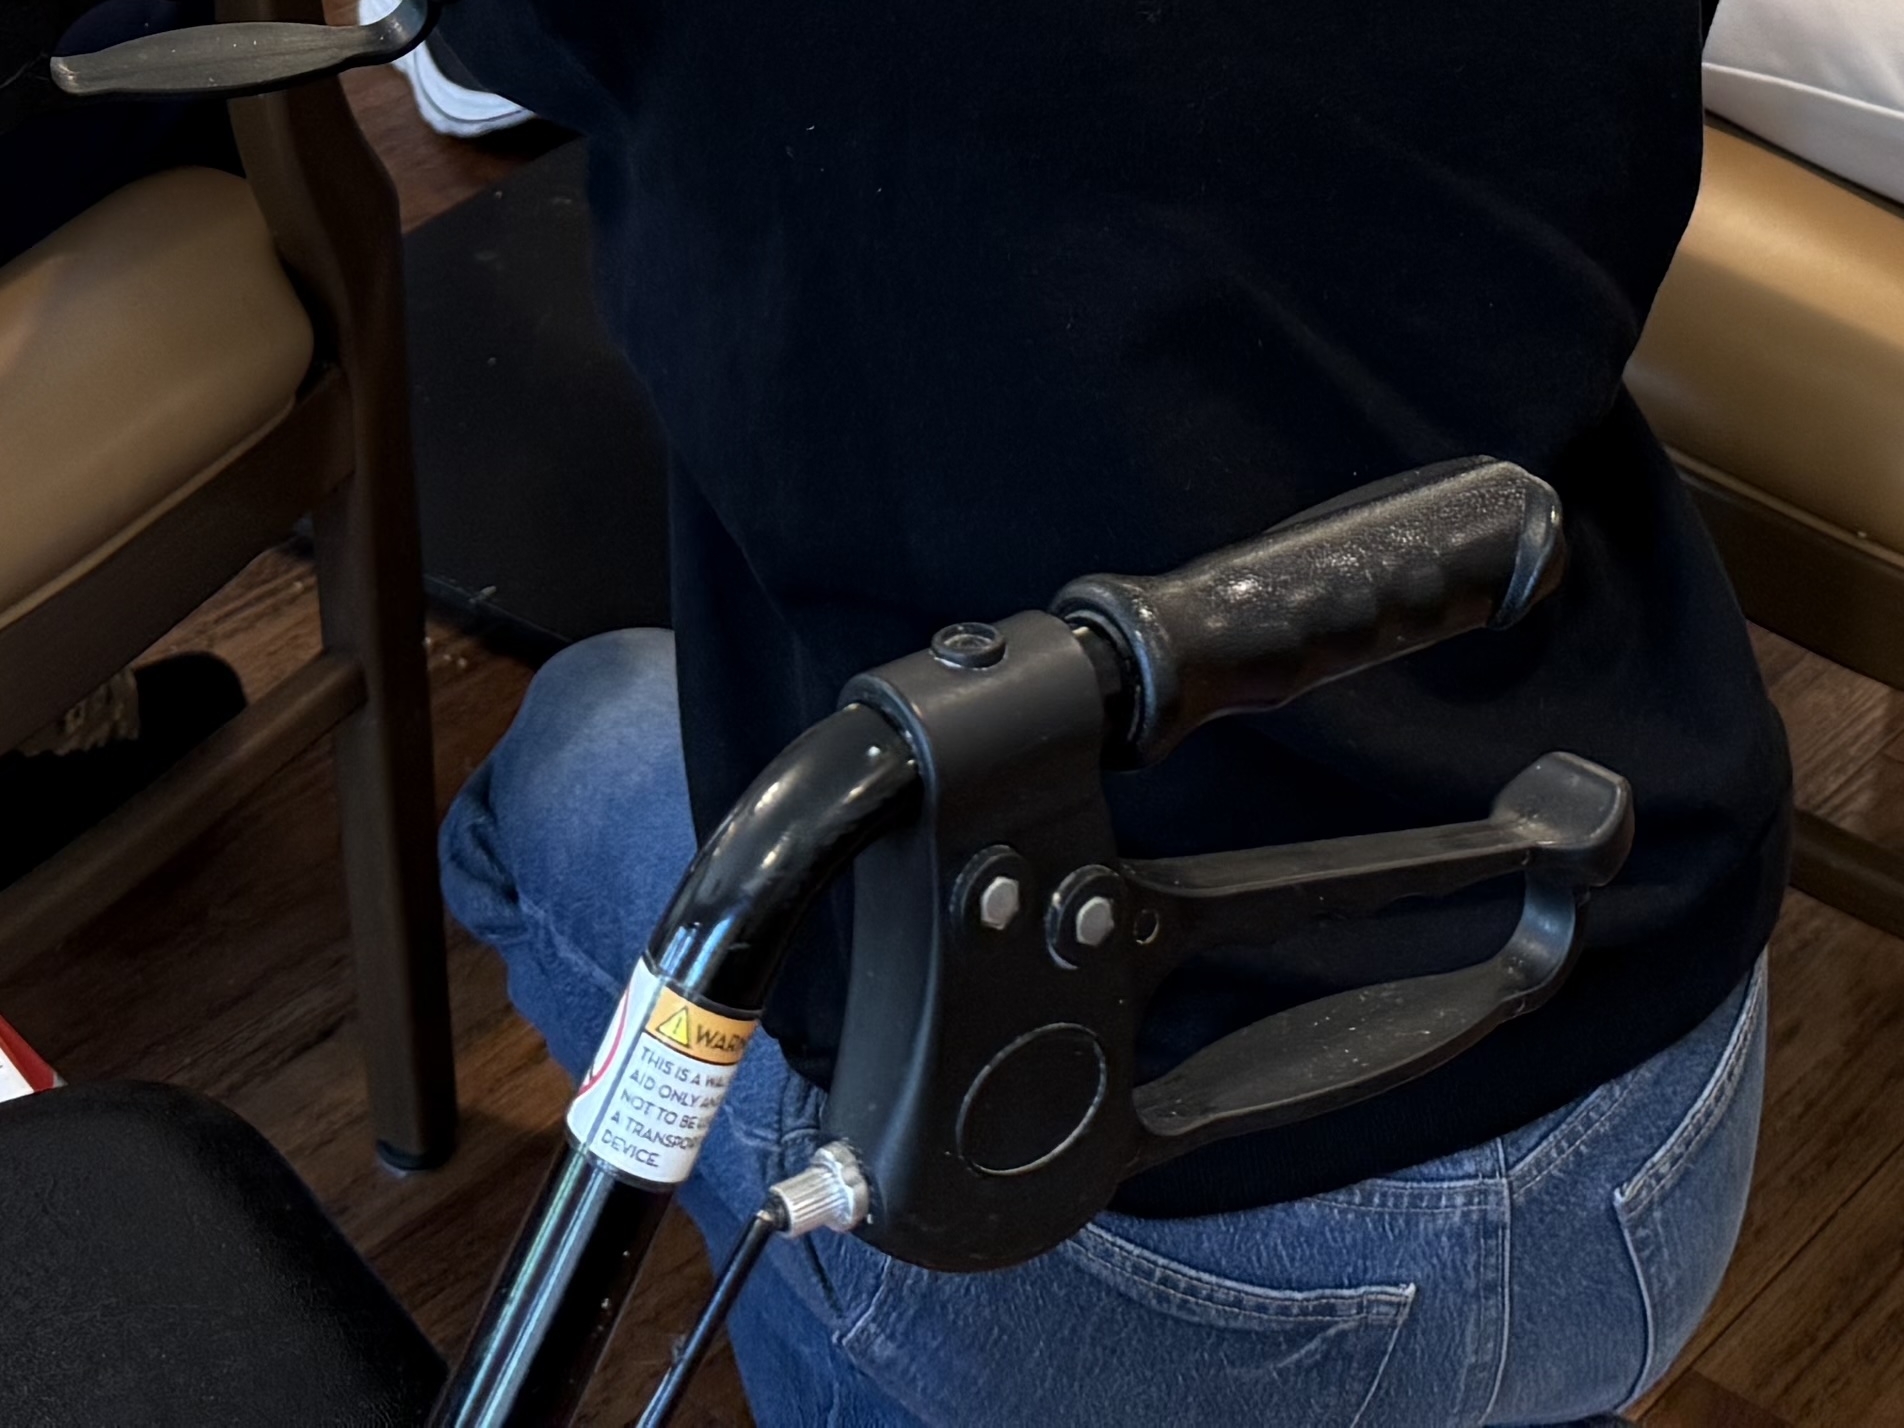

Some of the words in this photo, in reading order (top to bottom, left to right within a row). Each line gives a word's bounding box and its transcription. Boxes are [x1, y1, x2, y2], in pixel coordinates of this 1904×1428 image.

[641, 1046, 674, 1075] THIS
[675, 1066, 689, 1085] IS
[691, 1073, 701, 1086] A
[629, 1069, 655, 1092] AID
[658, 1084, 700, 1108] ONLY
[611, 1110, 621, 1124] A
[620, 1088, 652, 1116] NOT
[657, 1106, 678, 1125] TO
[680, 1114, 698, 1130] BE
